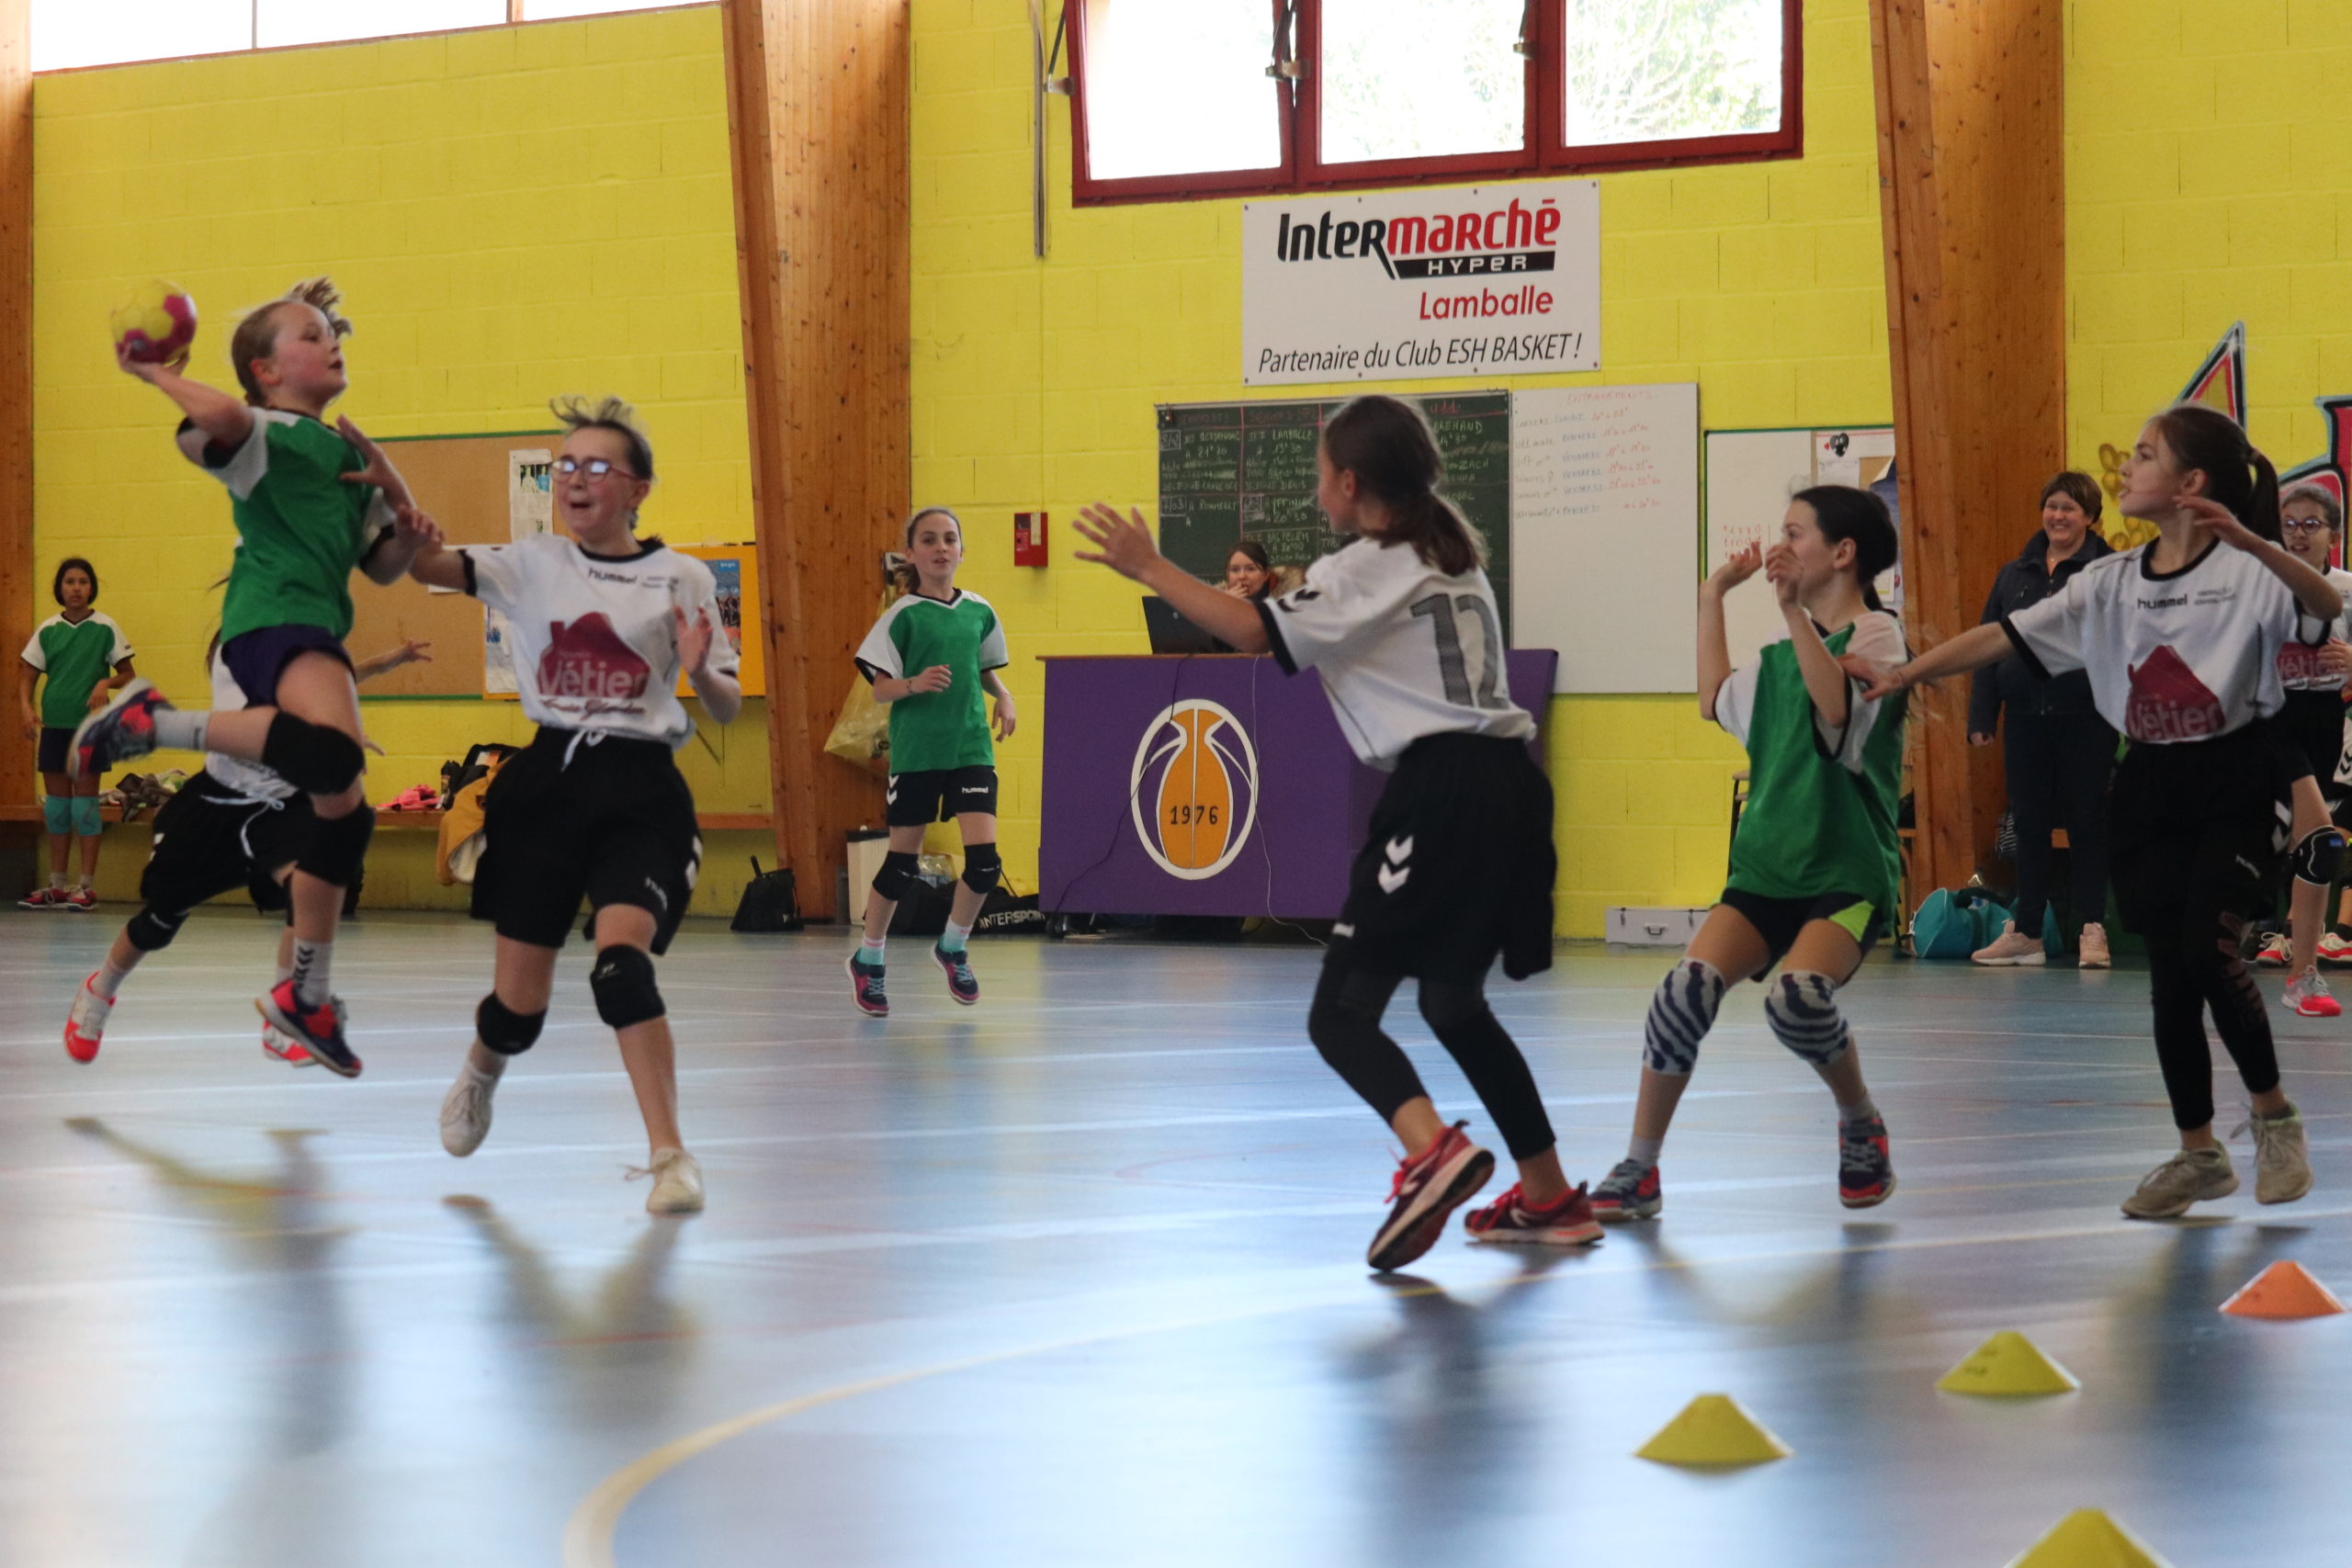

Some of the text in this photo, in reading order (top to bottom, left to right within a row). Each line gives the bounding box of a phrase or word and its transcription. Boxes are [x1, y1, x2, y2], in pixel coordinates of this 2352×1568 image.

[1428, 255, 1528, 275] HYPER
[1419, 285, 1554, 321] Lamballe
[1259, 344, 1359, 374] Partenaire
[1364, 341, 1389, 367] du
[1395, 338, 1442, 366] Club
[1446, 337, 1487, 365] ESH
[1491, 333, 1572, 362] BASKET
[2137, 593, 2188, 610] hummel
[1170, 804, 1219, 826] 1976
